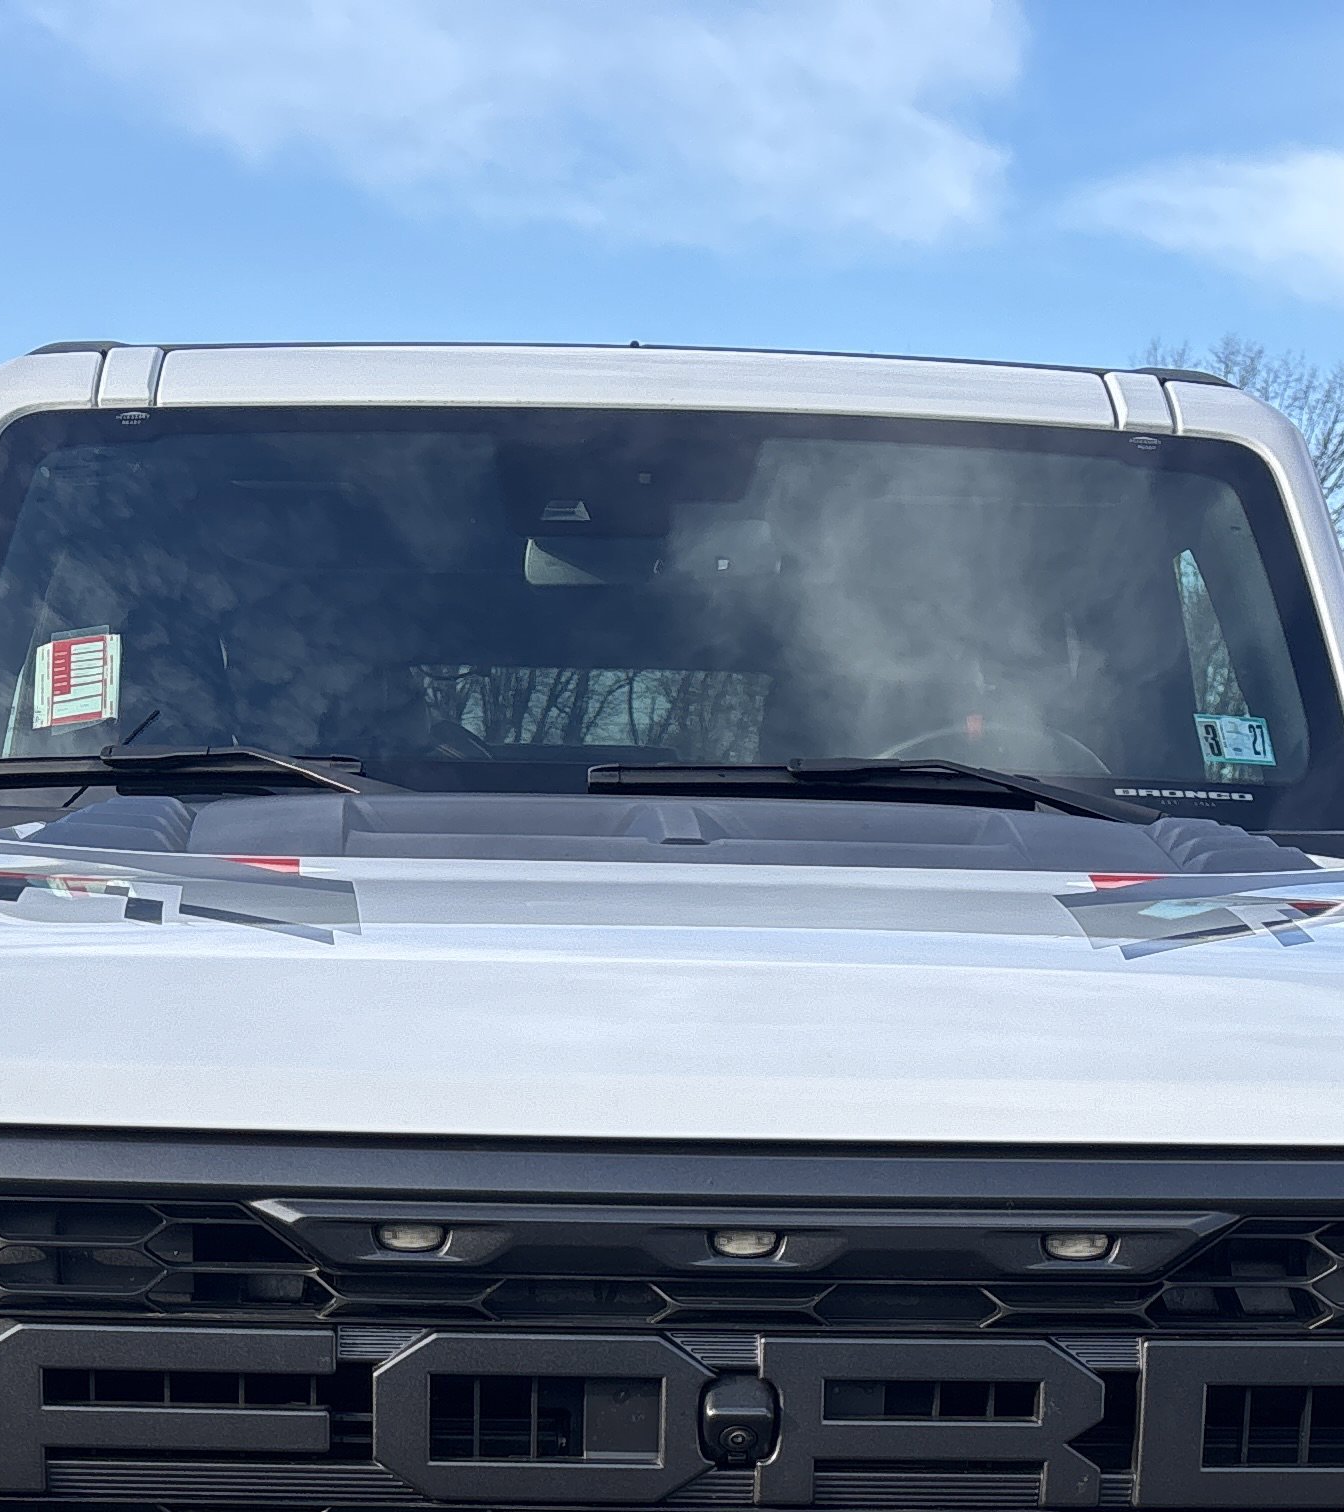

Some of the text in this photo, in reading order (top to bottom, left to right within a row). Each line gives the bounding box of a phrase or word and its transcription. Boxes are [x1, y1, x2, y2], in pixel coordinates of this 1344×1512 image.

[1204, 723, 1267, 758] 3 27
[1114, 788, 1254, 801] BRONCO
